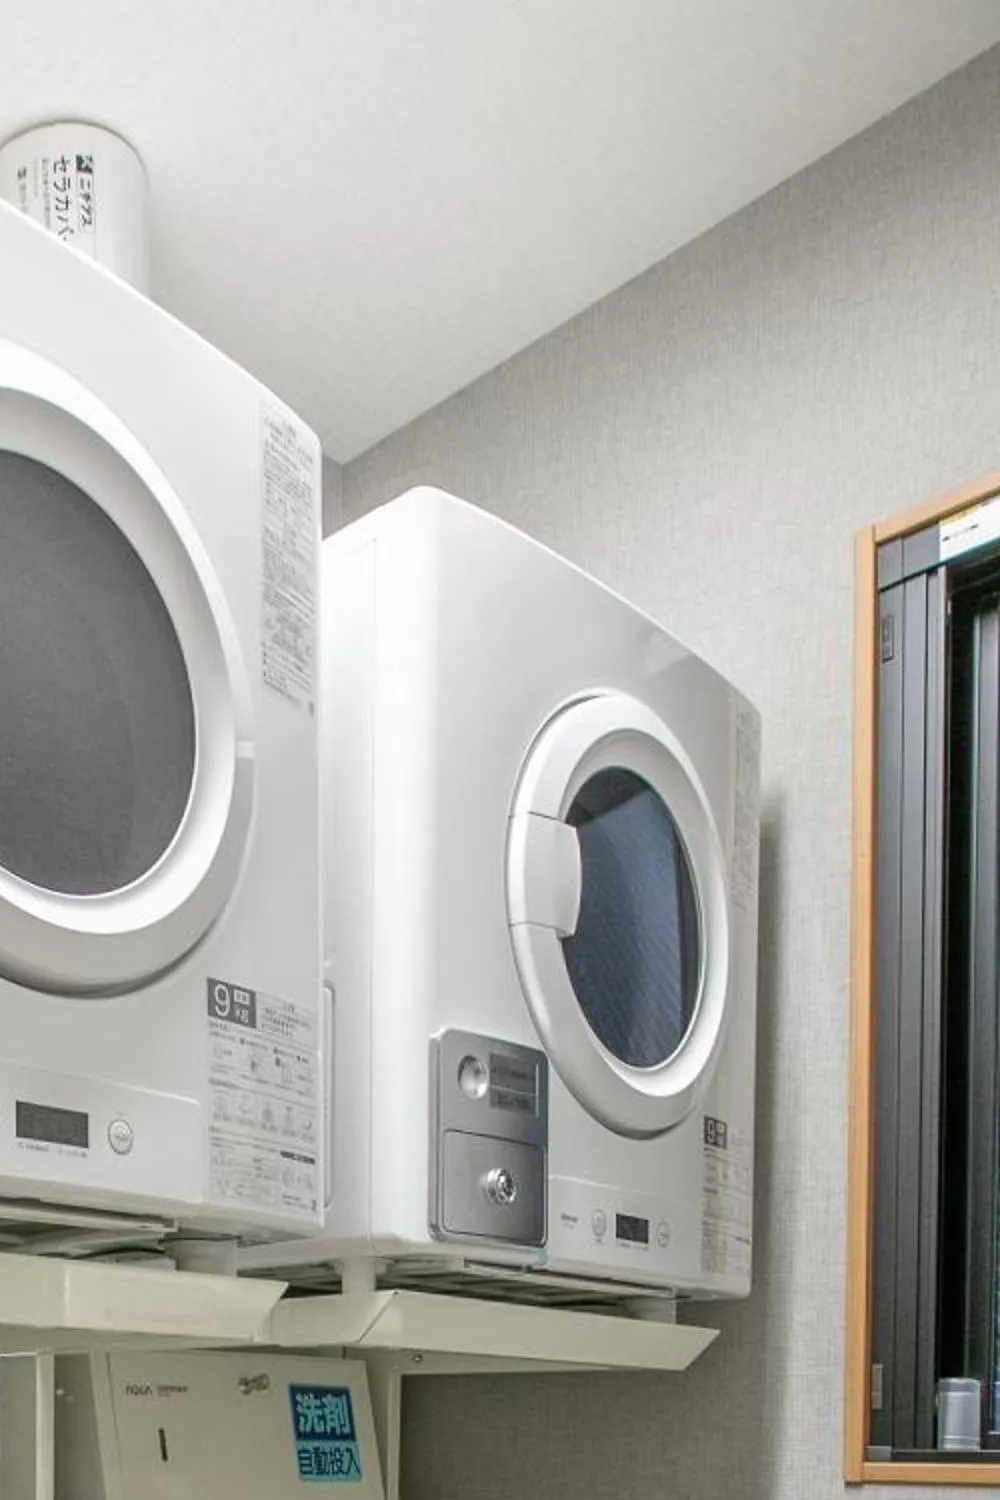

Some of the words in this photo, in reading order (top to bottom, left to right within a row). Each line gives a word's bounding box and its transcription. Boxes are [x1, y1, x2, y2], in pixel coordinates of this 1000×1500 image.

[53, 154, 74, 240] セラカバ
[215, 983, 230, 1017] 9
[296, 1393, 351, 1435] 洗剤
[298, 1446, 361, 1476] 自動投入
